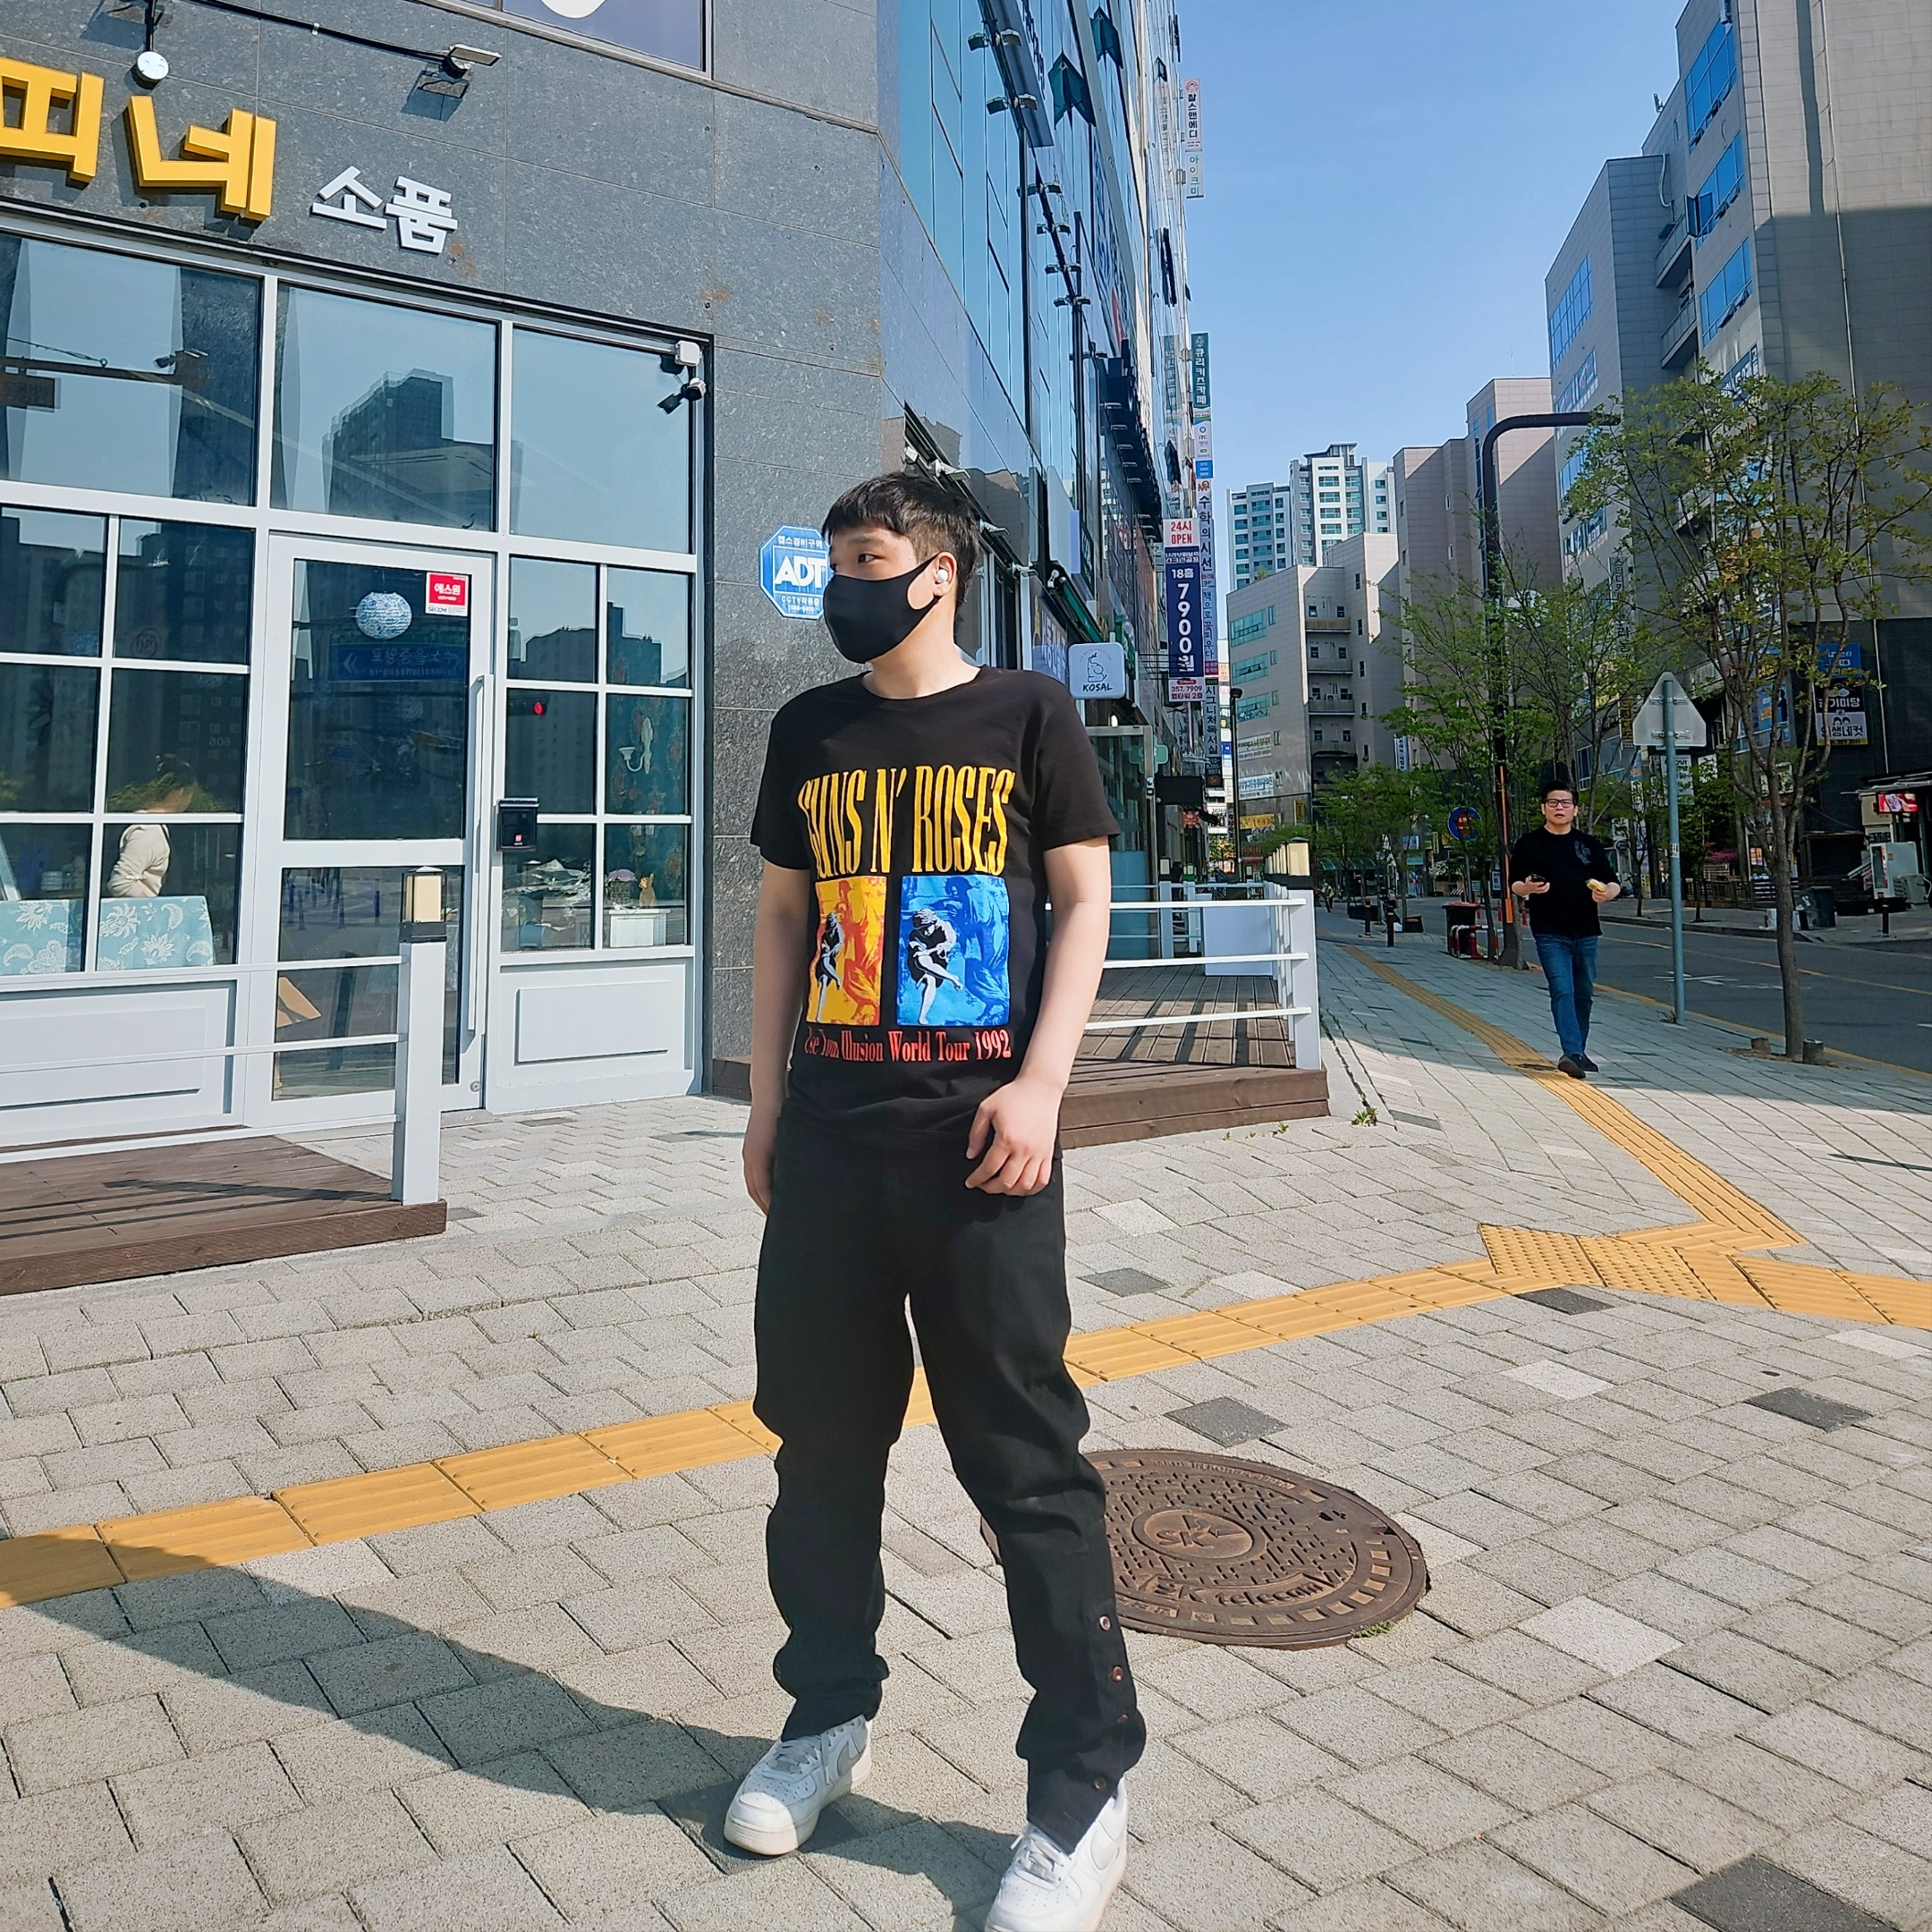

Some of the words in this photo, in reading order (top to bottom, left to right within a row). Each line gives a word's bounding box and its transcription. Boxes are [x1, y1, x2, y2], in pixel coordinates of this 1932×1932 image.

[310, 165, 459, 255] 소품
[1171, 521, 1192, 532] 24시
[1171, 533, 1192, 545] OPEN
[775, 555, 826, 589] ADT
[1171, 568, 1194, 580] 18홀
[434, 582, 462, 597] 에스원
[1082, 682, 1114, 693] KOSAL
[911, 764, 1016, 877] ROSES
[841, 1030, 884, 1063] Illusion
[887, 1030, 932, 1063] World
[935, 1030, 971, 1063] Tour
[973, 1029, 1013, 1062] 1992
[1156, 1530, 1215, 1549] SK
[1153, 1582, 1208, 1605] SK
[1215, 1580, 1326, 1606] telecom
